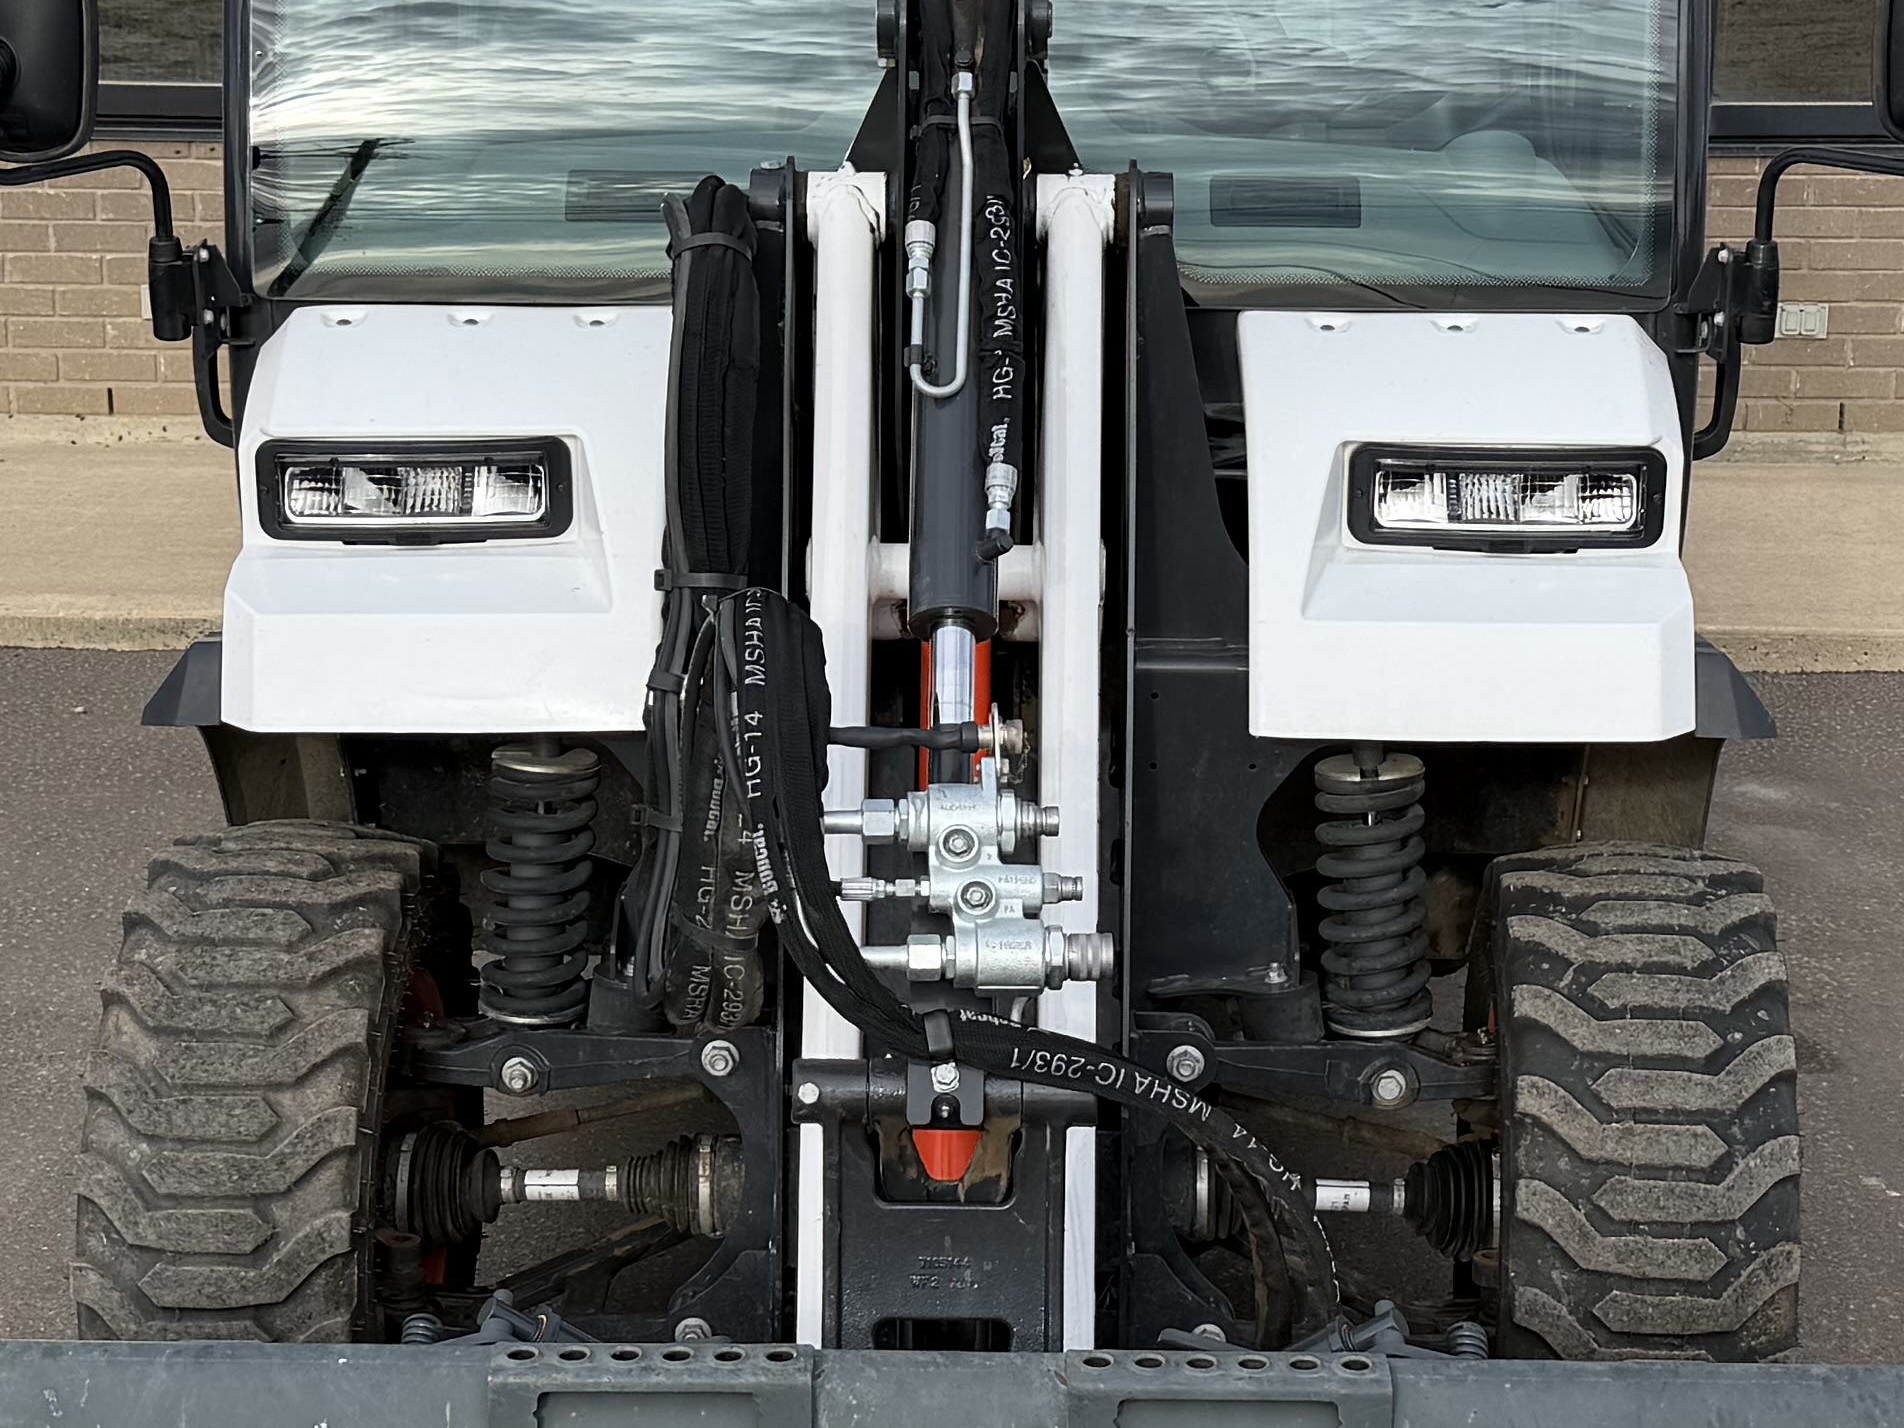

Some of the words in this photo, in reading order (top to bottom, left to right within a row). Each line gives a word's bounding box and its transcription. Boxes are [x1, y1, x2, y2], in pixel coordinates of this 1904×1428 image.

[993, 278, 1016, 338] MSHA
[744, 710, 764, 799] HG-14
[1010, 1047, 1127, 1090] IC-293/1
[1134, 1071, 1212, 1122] MSHA
